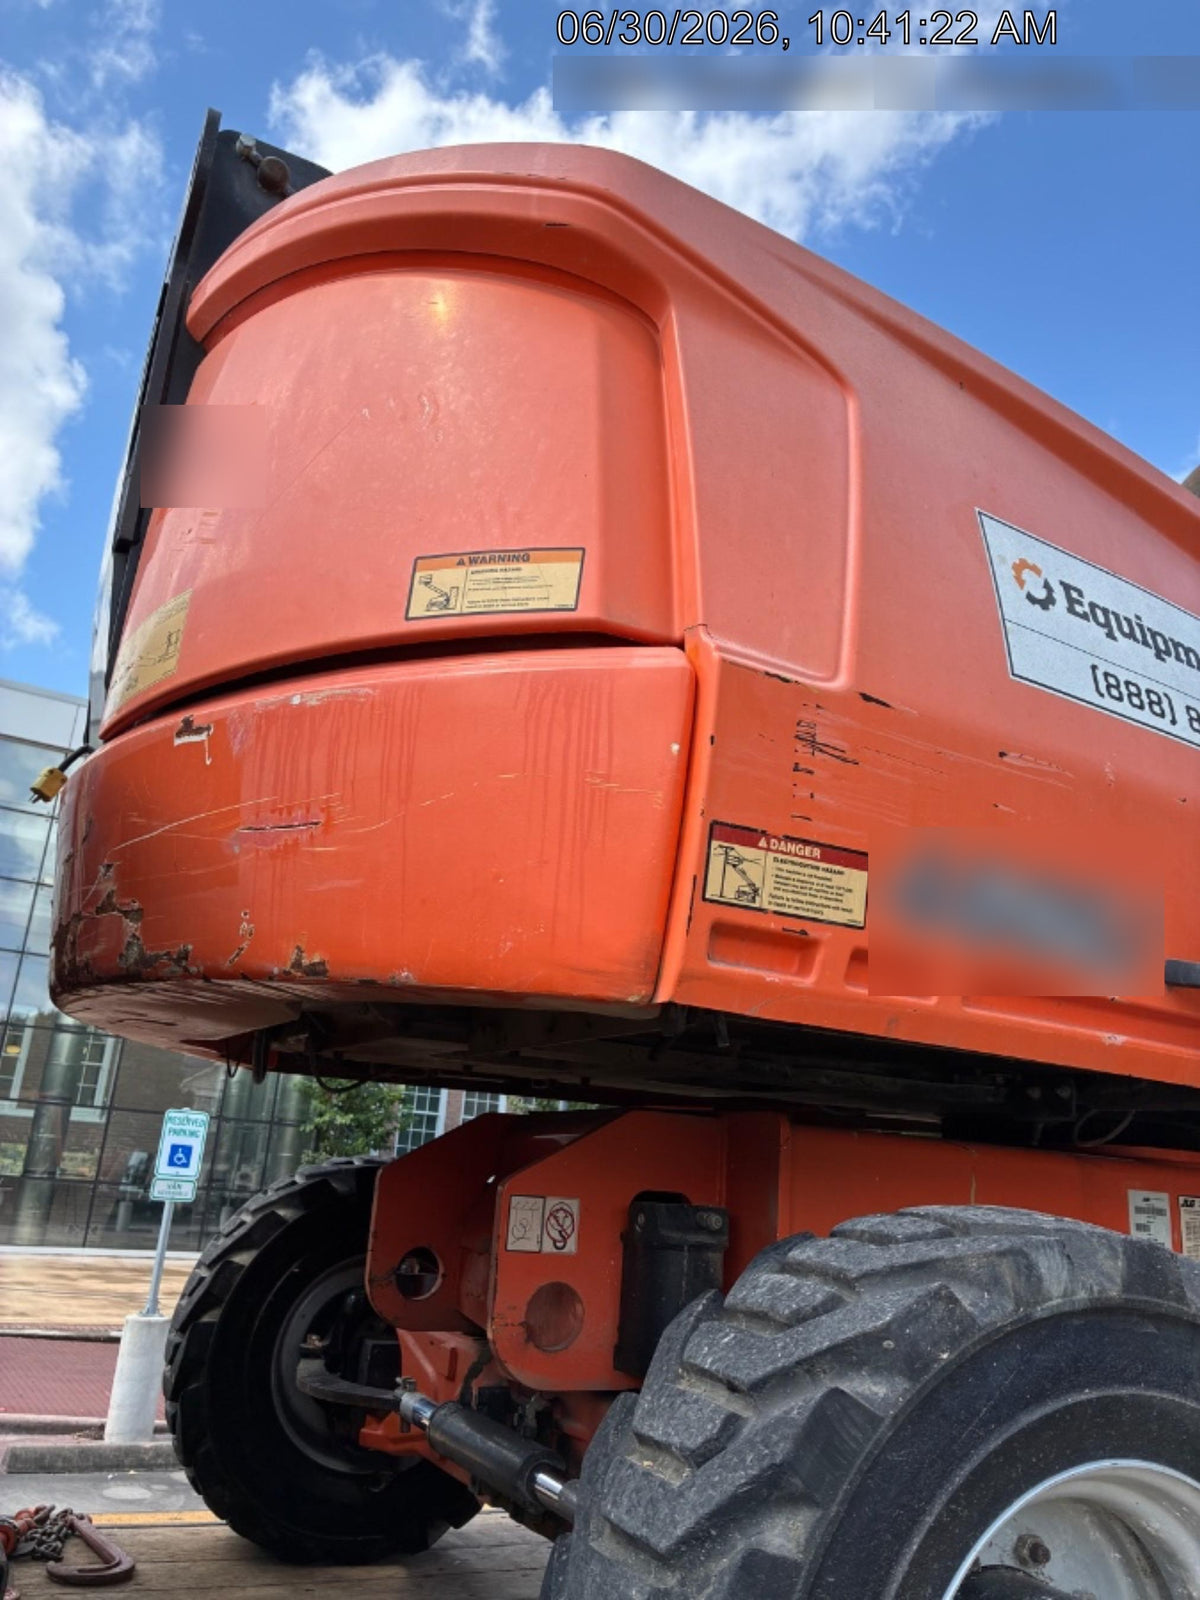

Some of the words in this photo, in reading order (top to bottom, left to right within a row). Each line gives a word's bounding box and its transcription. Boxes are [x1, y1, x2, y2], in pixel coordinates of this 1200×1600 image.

[468, 552, 531, 566] WARNING
[1090, 663, 1178, 726] (888)
[769, 838, 821, 859] DANGER
